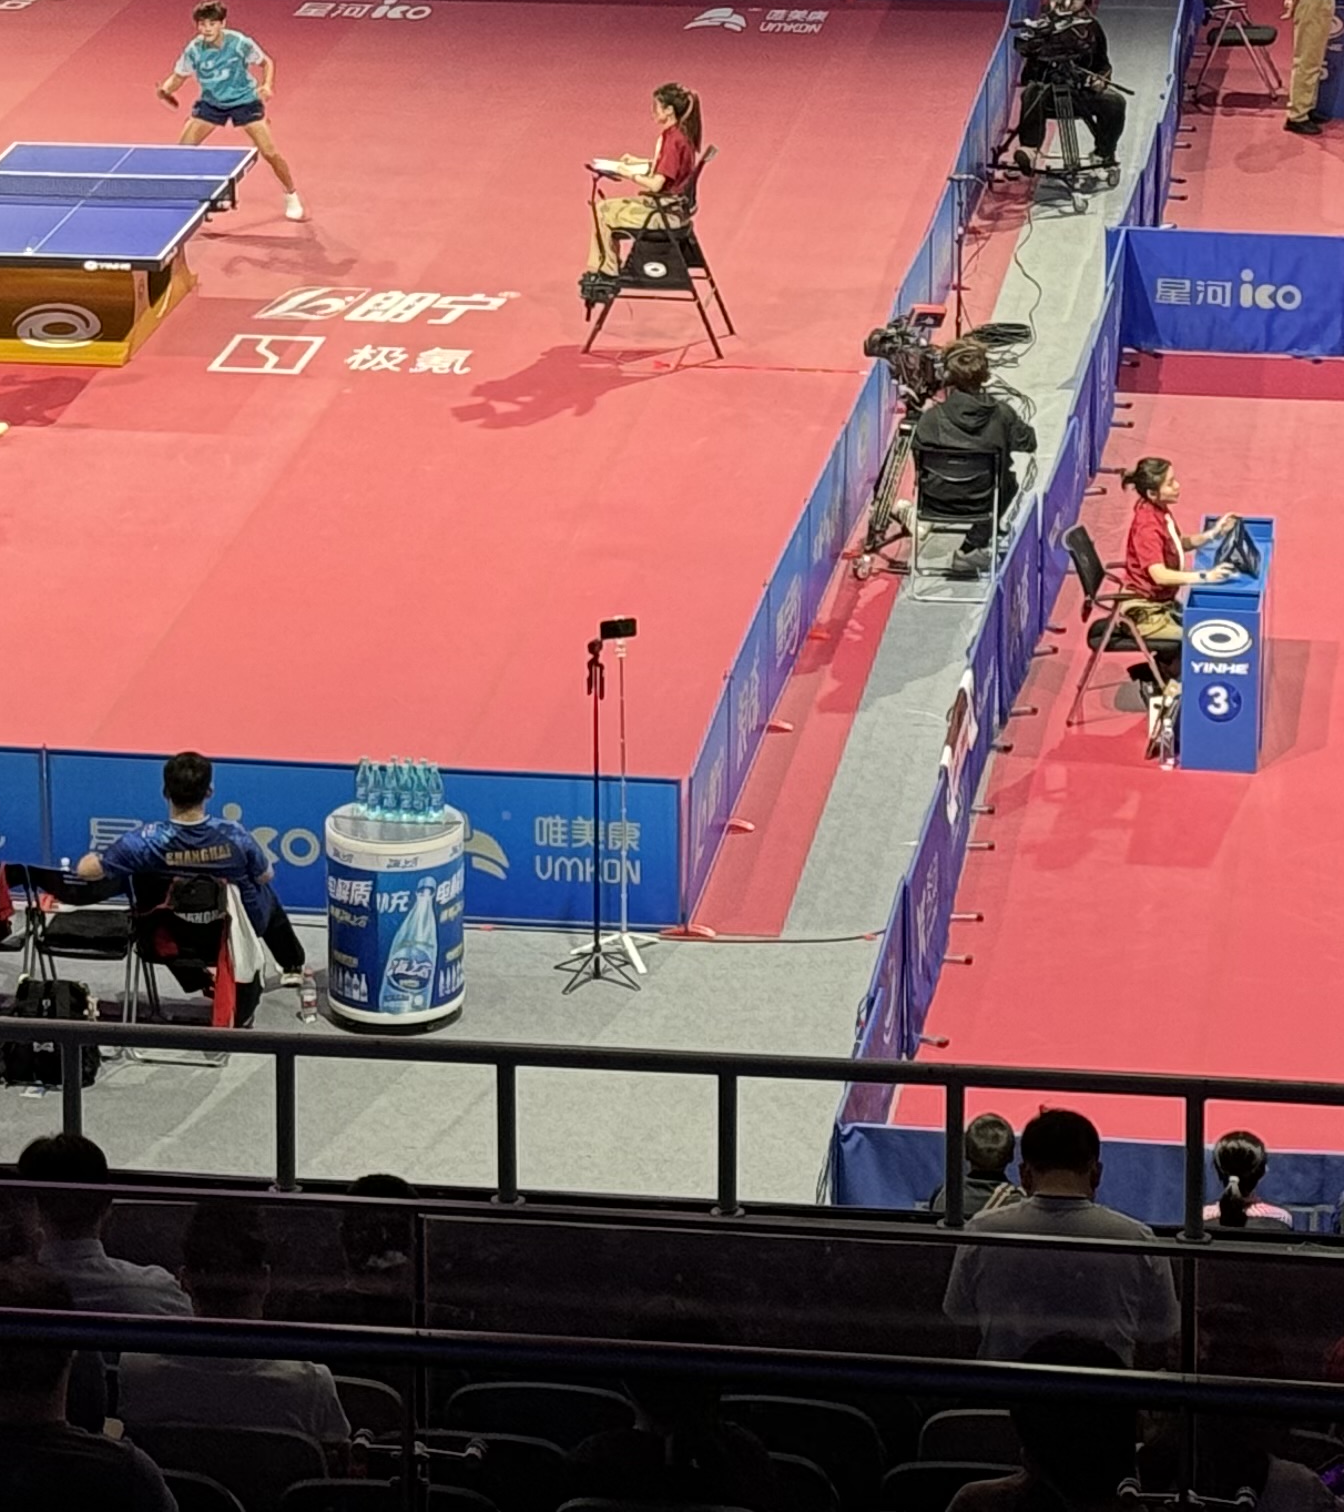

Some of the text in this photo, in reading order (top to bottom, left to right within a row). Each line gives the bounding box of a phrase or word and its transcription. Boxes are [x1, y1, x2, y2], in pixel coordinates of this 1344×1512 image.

[345, 290, 508, 325] 朗宁
[344, 344, 475, 375] 极氪
[1190, 661, 1250, 676] YINHE
[1207, 686, 1231, 716] 3
[534, 814, 643, 851] 唯美康
[165, 843, 233, 867] SHANGHAI
